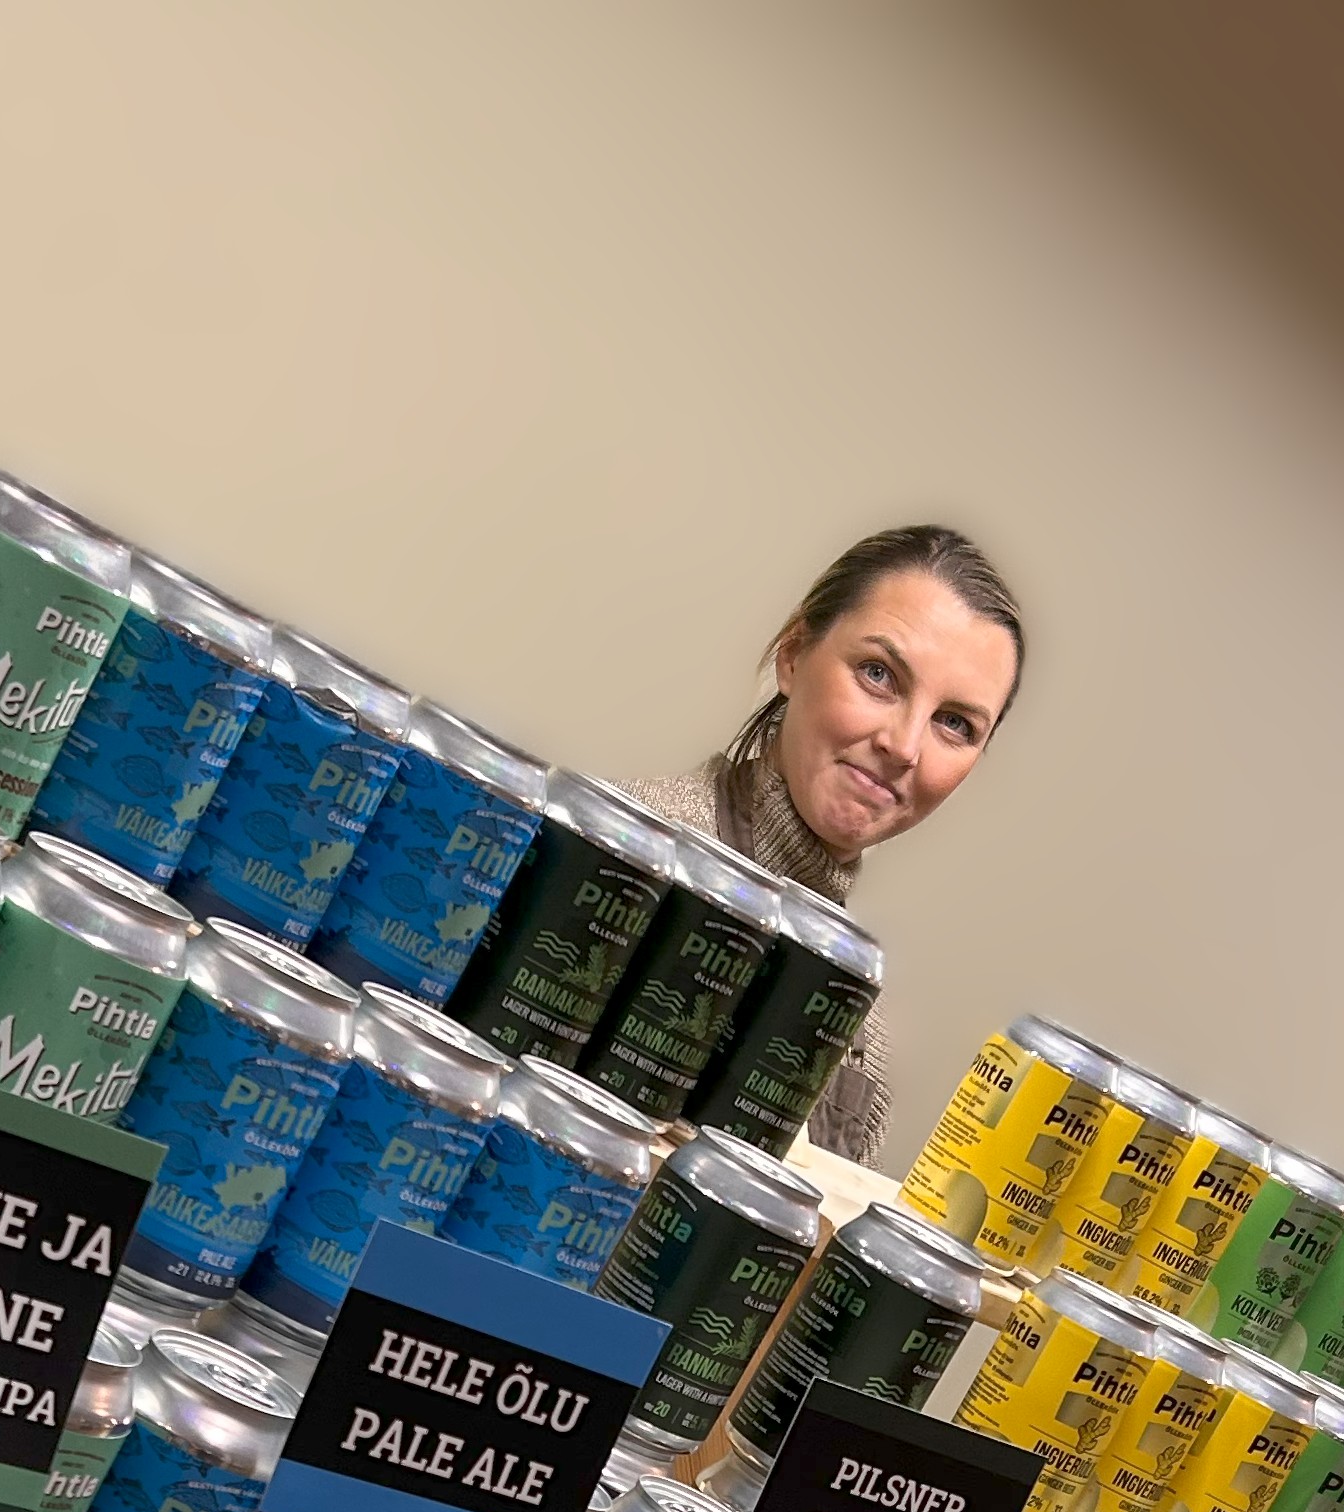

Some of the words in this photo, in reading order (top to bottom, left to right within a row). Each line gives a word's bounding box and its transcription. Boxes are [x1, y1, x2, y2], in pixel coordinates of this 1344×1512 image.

[34, 604, 109, 662] Pihtla
[572, 880, 648, 938] Pihtla
[679, 932, 754, 988] Pihtla
[68, 986, 159, 1042] Pihtla
[609, 1041, 641, 1067] LAGER
[1193, 1170, 1257, 1215] Pihtla
[41, 1212, 113, 1277] JA
[1231, 1294, 1260, 1324] KOLM
[368, 1328, 496, 1406] HELE
[495, 1363, 590, 1434] ÕLU
[656, 1371, 686, 1397] LAGER
[1072, 1361, 1139, 1407] Pihtla
[340, 1407, 465, 1479] PALE
[461, 1447, 554, 1506] ALE
